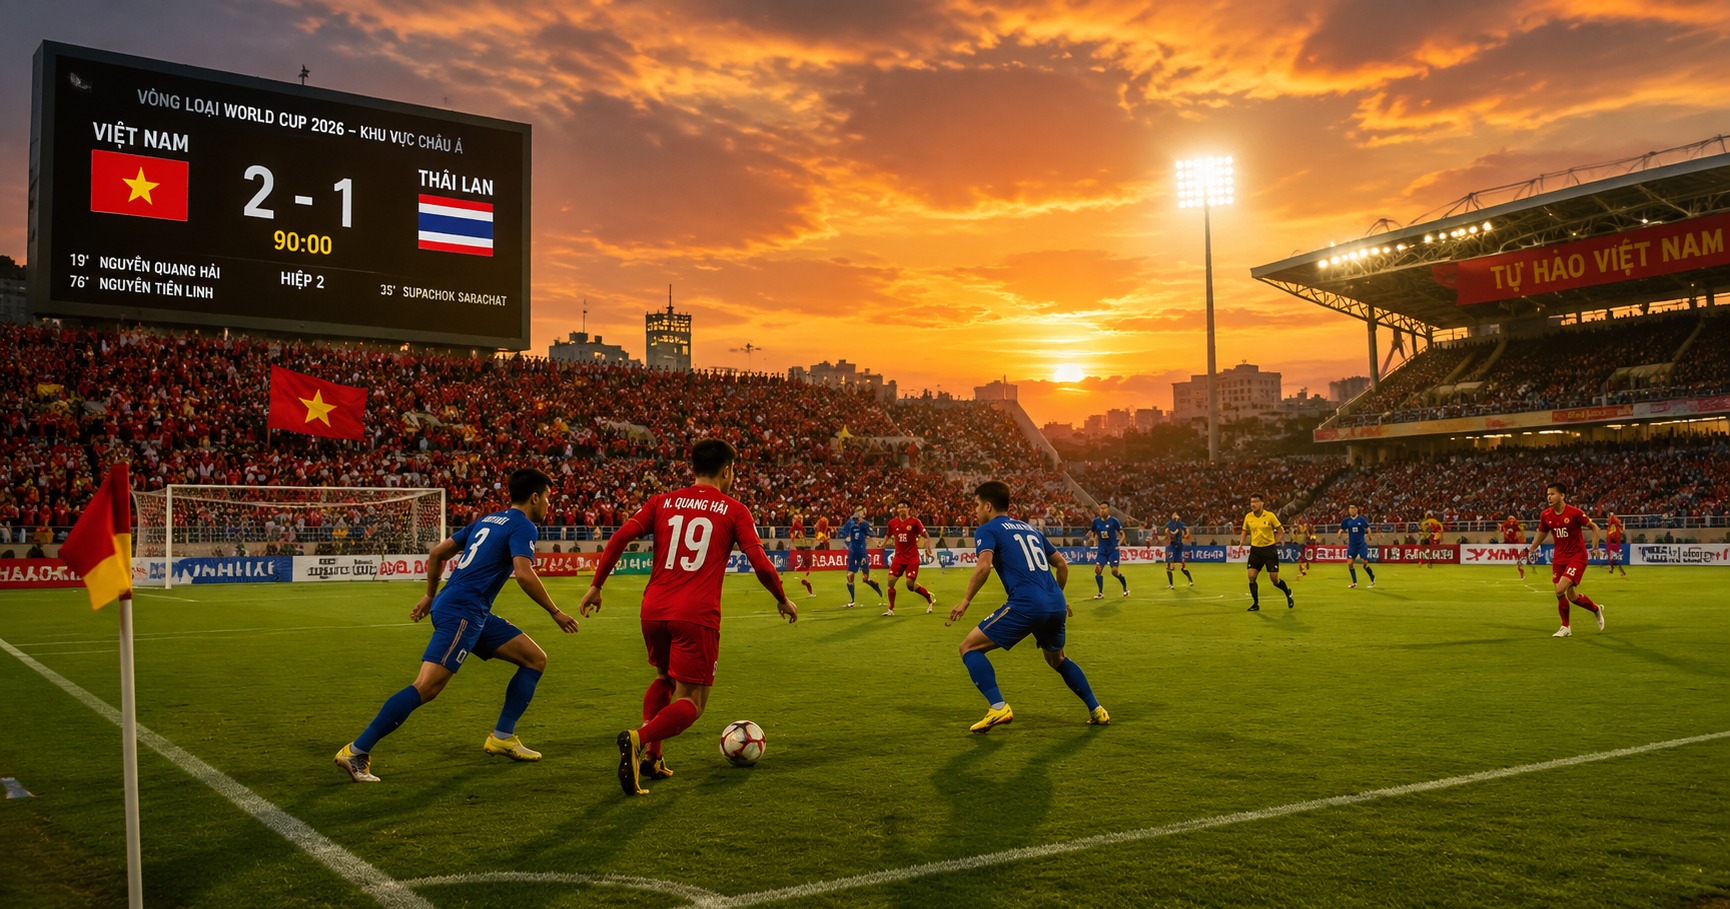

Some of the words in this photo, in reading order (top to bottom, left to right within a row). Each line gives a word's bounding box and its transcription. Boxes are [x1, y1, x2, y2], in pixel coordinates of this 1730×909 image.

[137, 87, 180, 109] VÒNG
[185, 96, 219, 118] LOẠI
[223, 102, 275, 124] WORLD
[278, 111, 307, 130] CUP
[310, 117, 345, 136] 2026
[360, 125, 387, 142] KHU
[389, 129, 415, 148] VỰC
[92, 120, 138, 150] VIỆT
[144, 129, 189, 153] NAM
[243, 164, 275, 220] 2
[333, 177, 353, 228] 1
[461, 175, 494, 196] LAN
[273, 228, 333, 256] 90:00
[154, 261, 196, 277] QUANG
[1490, 260, 1524, 292] TỰ
[1593, 237, 1651, 276] VIỆT
[1662, 228, 1725, 263] NAM
[185, 284, 214, 300] LINH
[280, 269, 313, 290] HIỆP
[316, 274, 325, 289] 2
[402, 285, 456, 302] SUPACHOK
[457, 291, 508, 307] SARACHAT
[663, 498, 673, 509] N.
[674, 497, 709, 511] QUANG
[457, 527, 491, 571] 3
[664, 514, 714, 572] 19
[1012, 533, 1049, 572] 16
